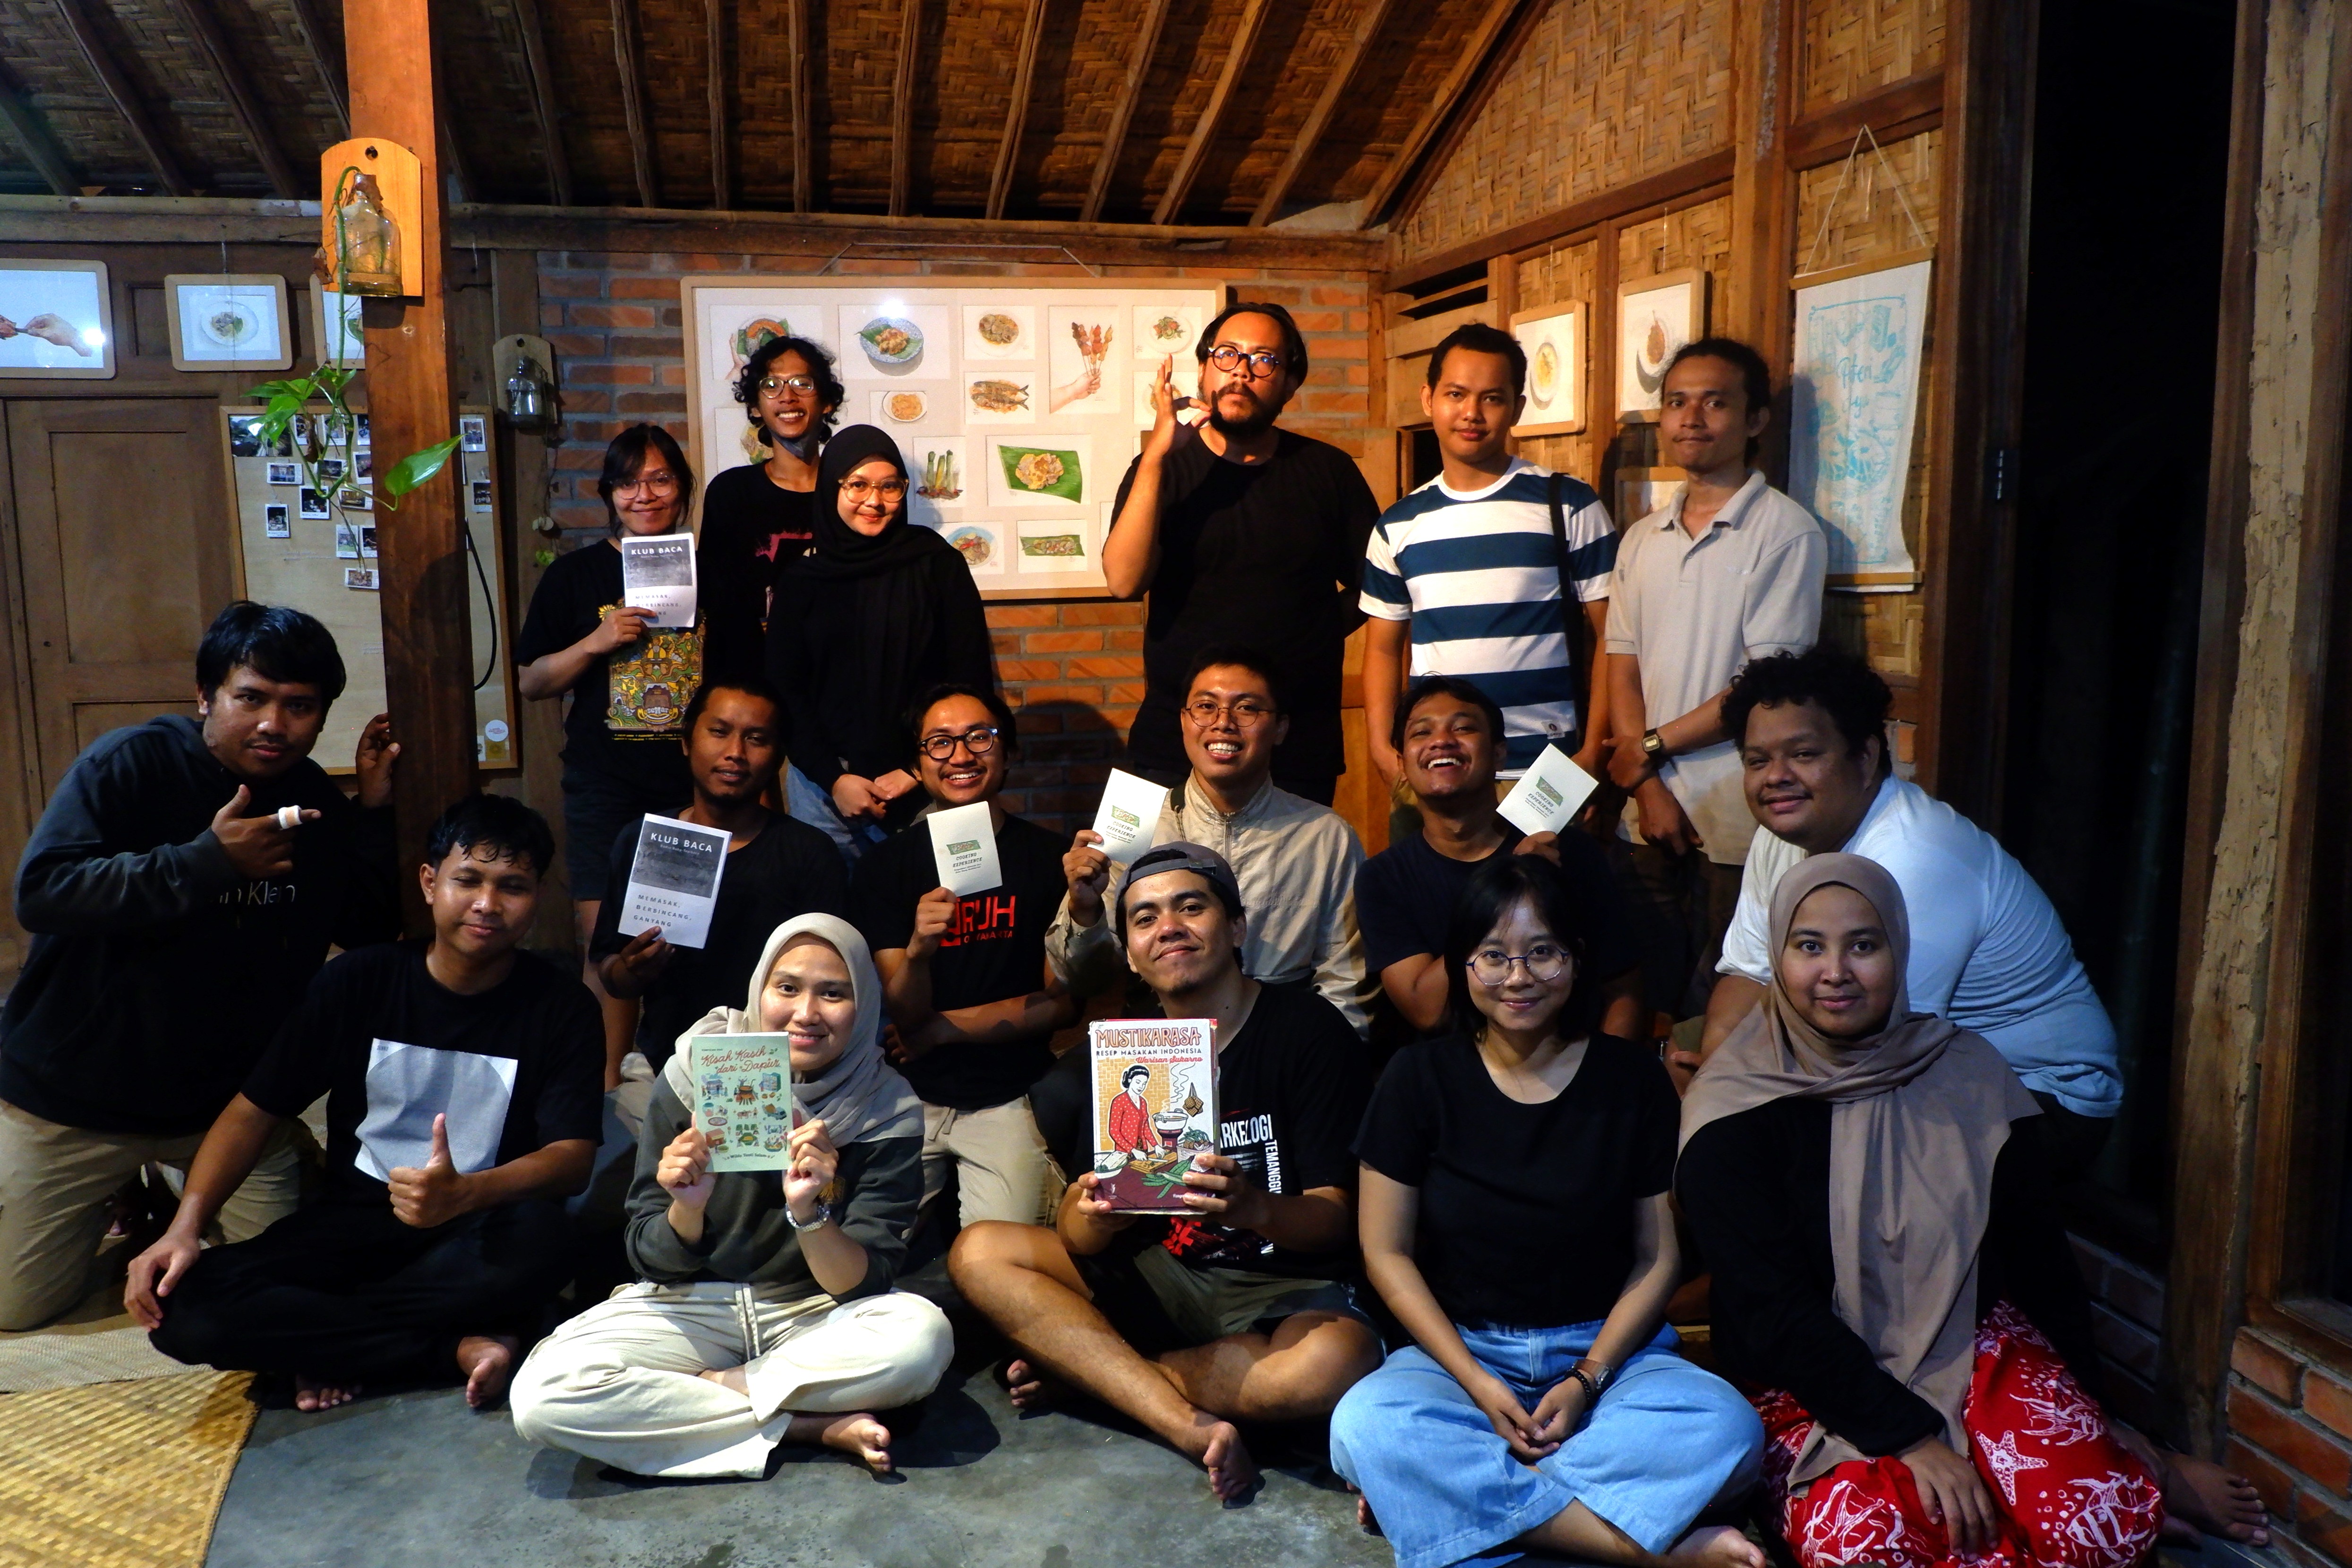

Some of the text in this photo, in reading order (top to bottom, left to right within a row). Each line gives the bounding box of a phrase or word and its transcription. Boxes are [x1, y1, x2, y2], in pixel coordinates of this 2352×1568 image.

[659, 546, 683, 554] BACA
[650, 832, 678, 845] KLUB
[684, 840, 712, 852] BACA
[956, 852, 977, 860] COOKING
[633, 915, 672, 927] GANYANG
[1095, 1027, 1202, 1048] MUSTIKARASA
[701, 1045, 767, 1067] Kisah Kasih
[1170, 1055, 1203, 1063] Sukarno
[716, 1059, 780, 1074] dari Dapur
